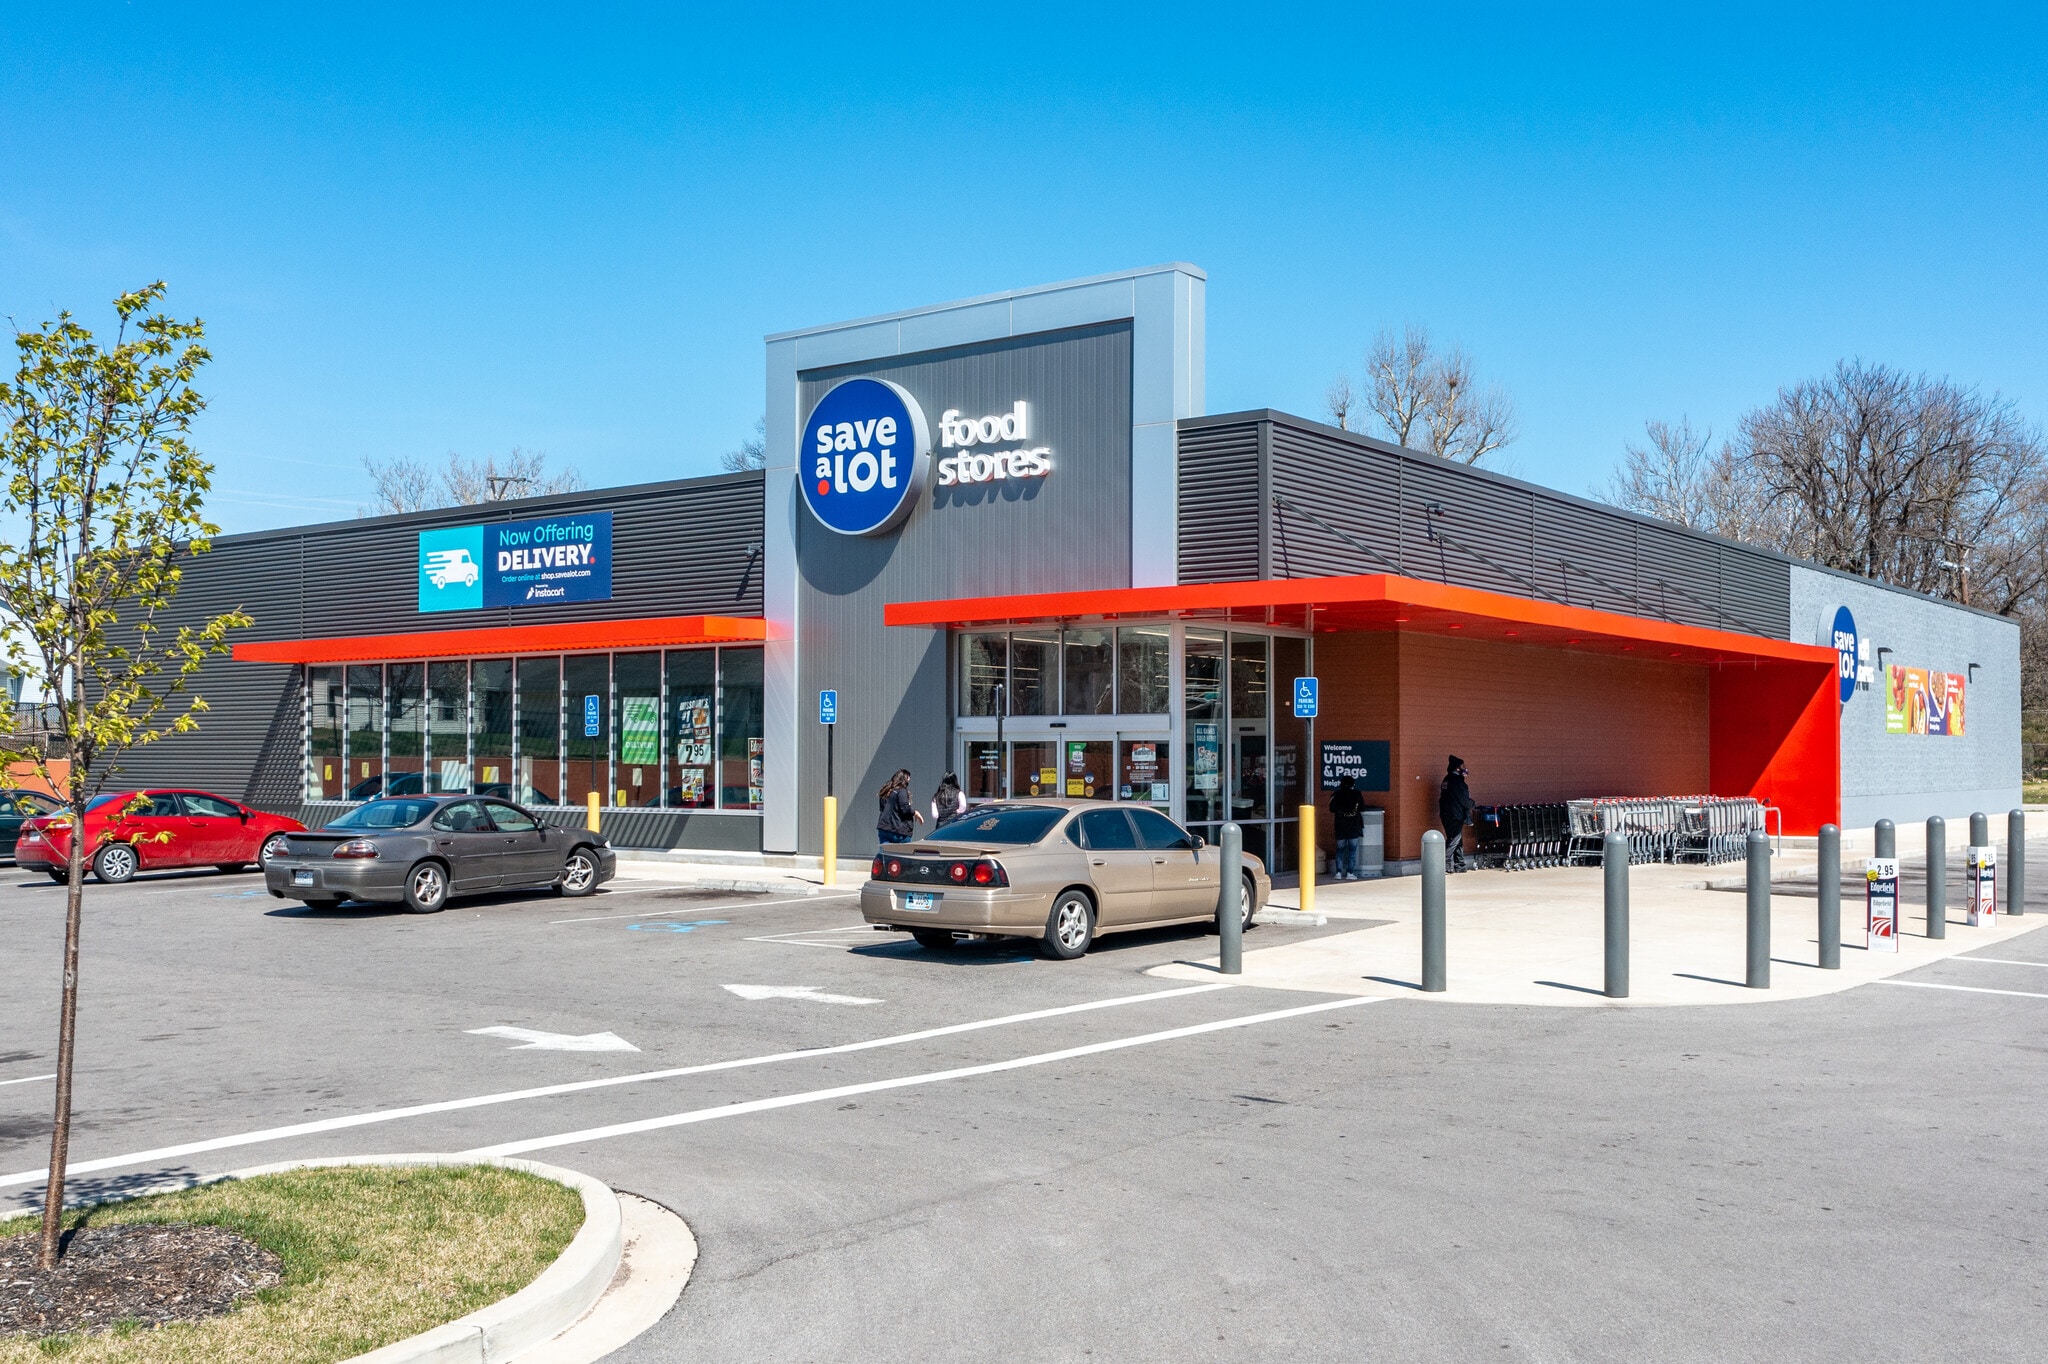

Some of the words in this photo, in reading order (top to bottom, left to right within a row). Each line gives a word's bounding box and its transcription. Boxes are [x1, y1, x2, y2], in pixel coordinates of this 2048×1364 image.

[817, 416, 897, 454] save
[939, 400, 1027, 448] food
[816, 457, 832, 479] a
[938, 446, 1051, 486] stores
[499, 529, 531, 546] Now
[533, 521, 594, 541] Offering
[501, 575, 517, 583] Order
[517, 573, 534, 582] online
[541, 569, 591, 580] shop.savealot.com
[1834, 630, 1855, 653] save
[1323, 751, 1362, 764] Union
[1323, 766, 1334, 777] &
[1335, 766, 1368, 779] Page
[1870, 882, 1895, 894] Edgefield
